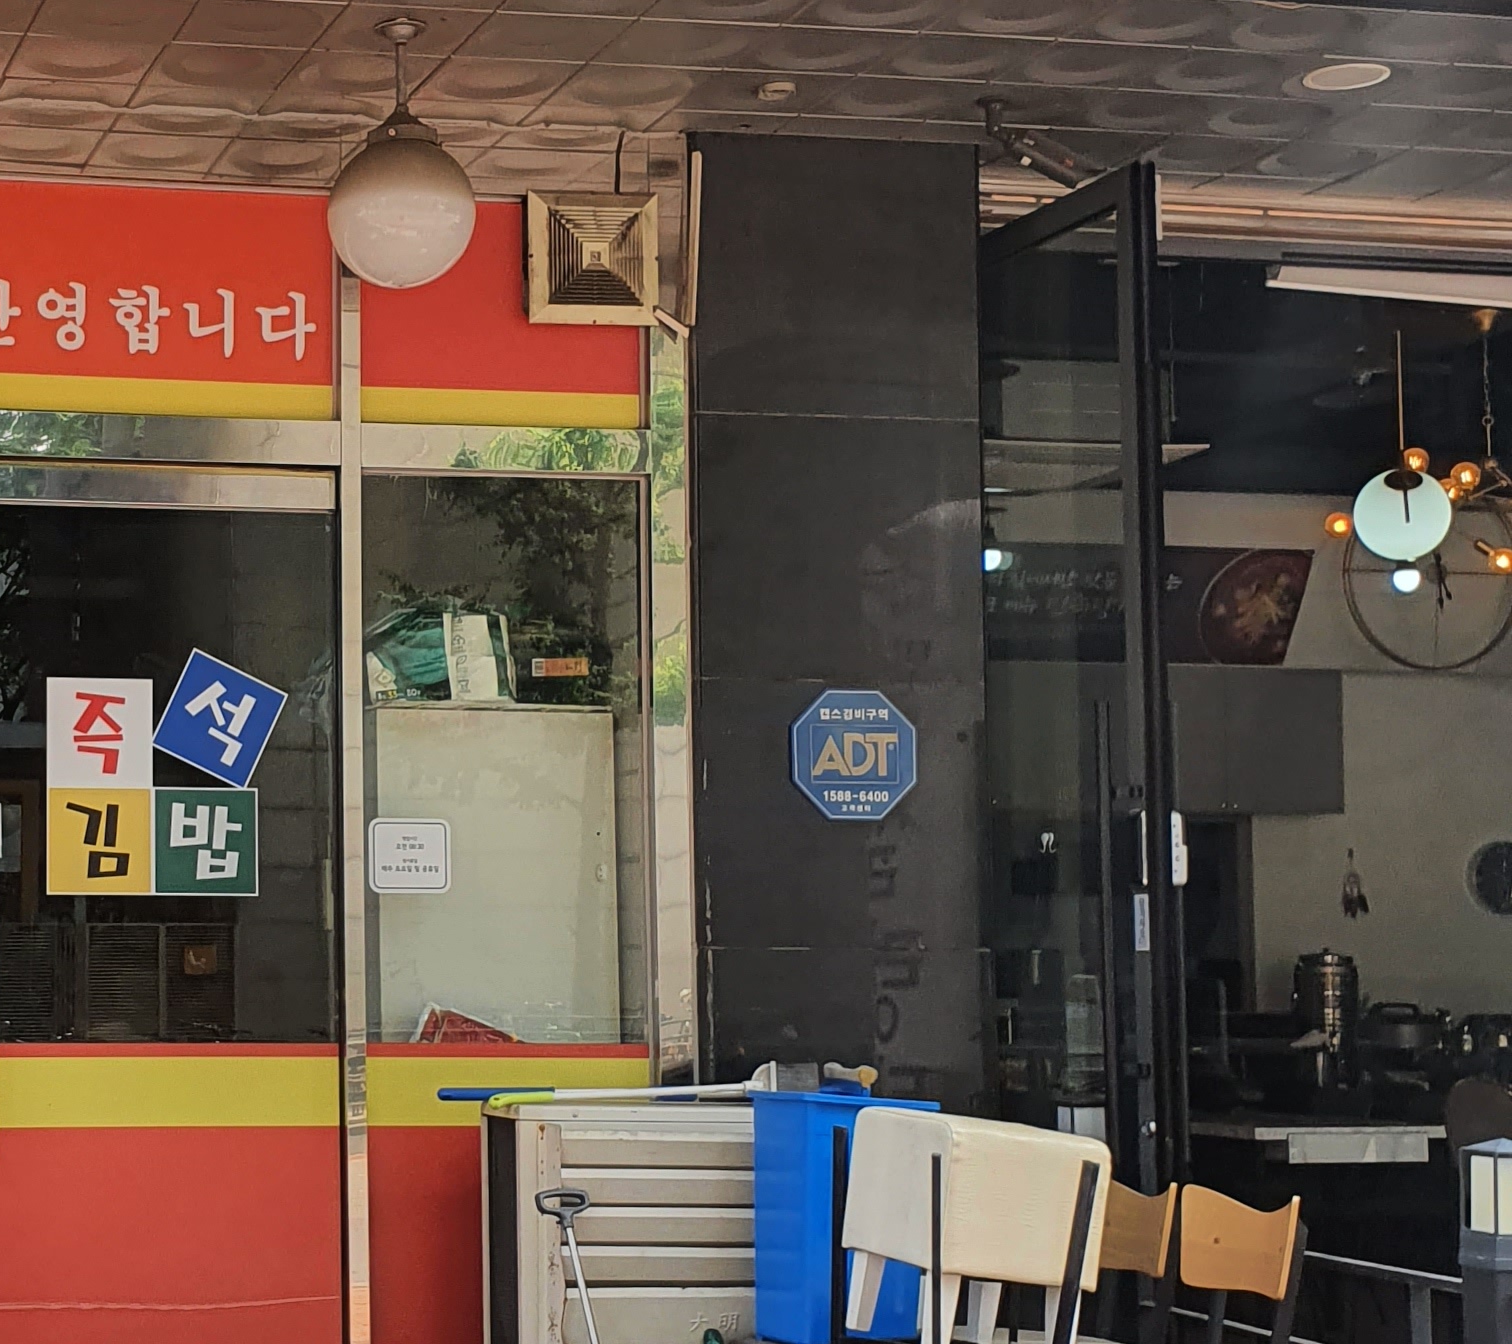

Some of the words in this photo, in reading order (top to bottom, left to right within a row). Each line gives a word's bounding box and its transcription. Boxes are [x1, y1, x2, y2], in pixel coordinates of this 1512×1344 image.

[812, 731, 899, 777] ADT
[823, 789, 890, 803] 1588-6400
[65, 801, 242, 880] 김밥
